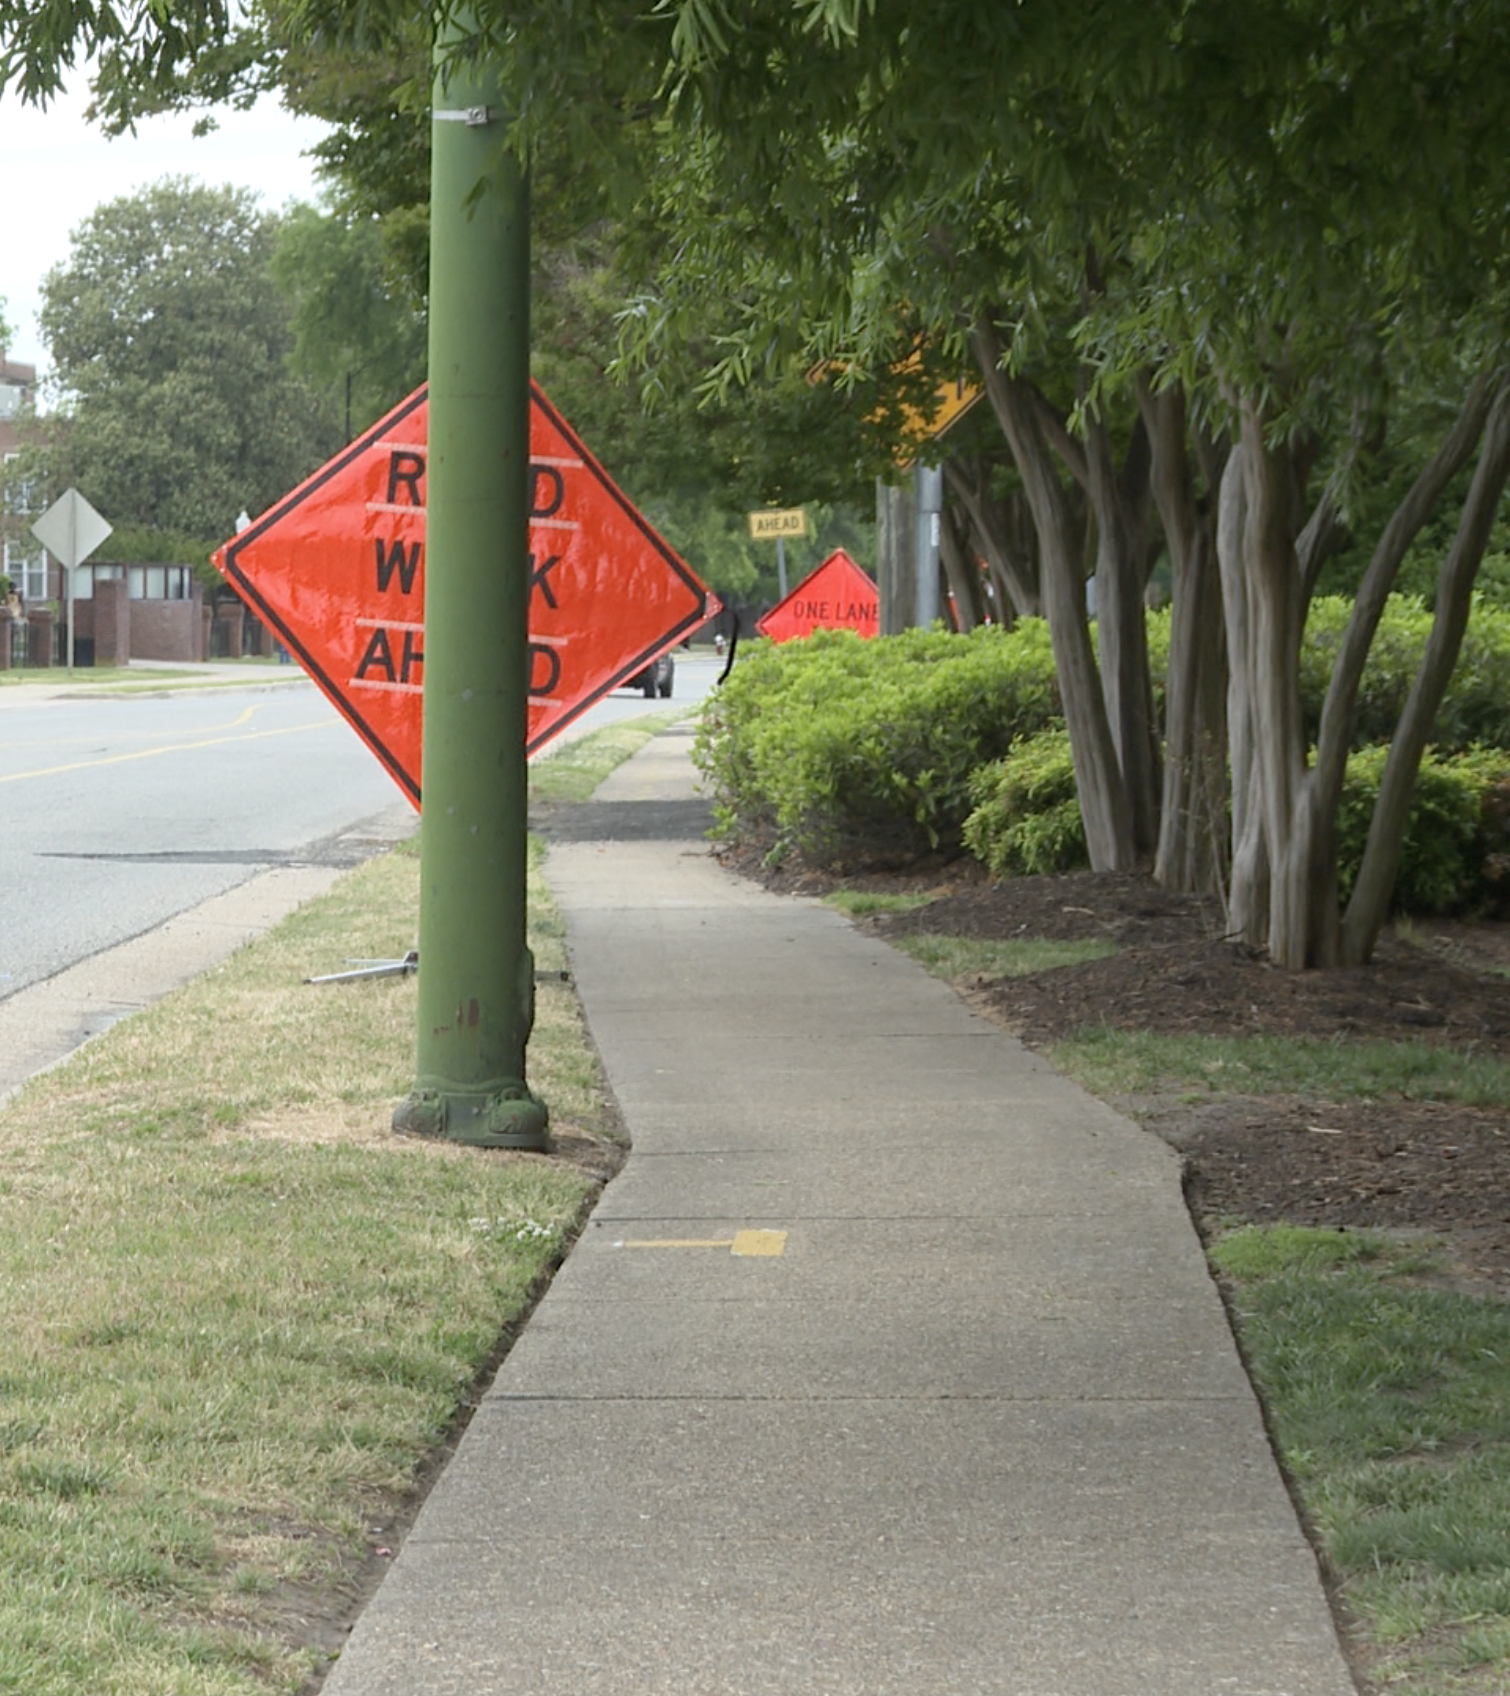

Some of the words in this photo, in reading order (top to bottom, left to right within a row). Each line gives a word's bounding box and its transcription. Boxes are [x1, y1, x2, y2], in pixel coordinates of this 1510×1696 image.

[386, 450, 564, 518] RD
[756, 515, 799, 533] AHEAD
[375, 538, 561, 609] WK
[793, 600, 829, 619] ONE
[835, 602, 879, 621] LANE
[355, 627, 561, 697] AHD
